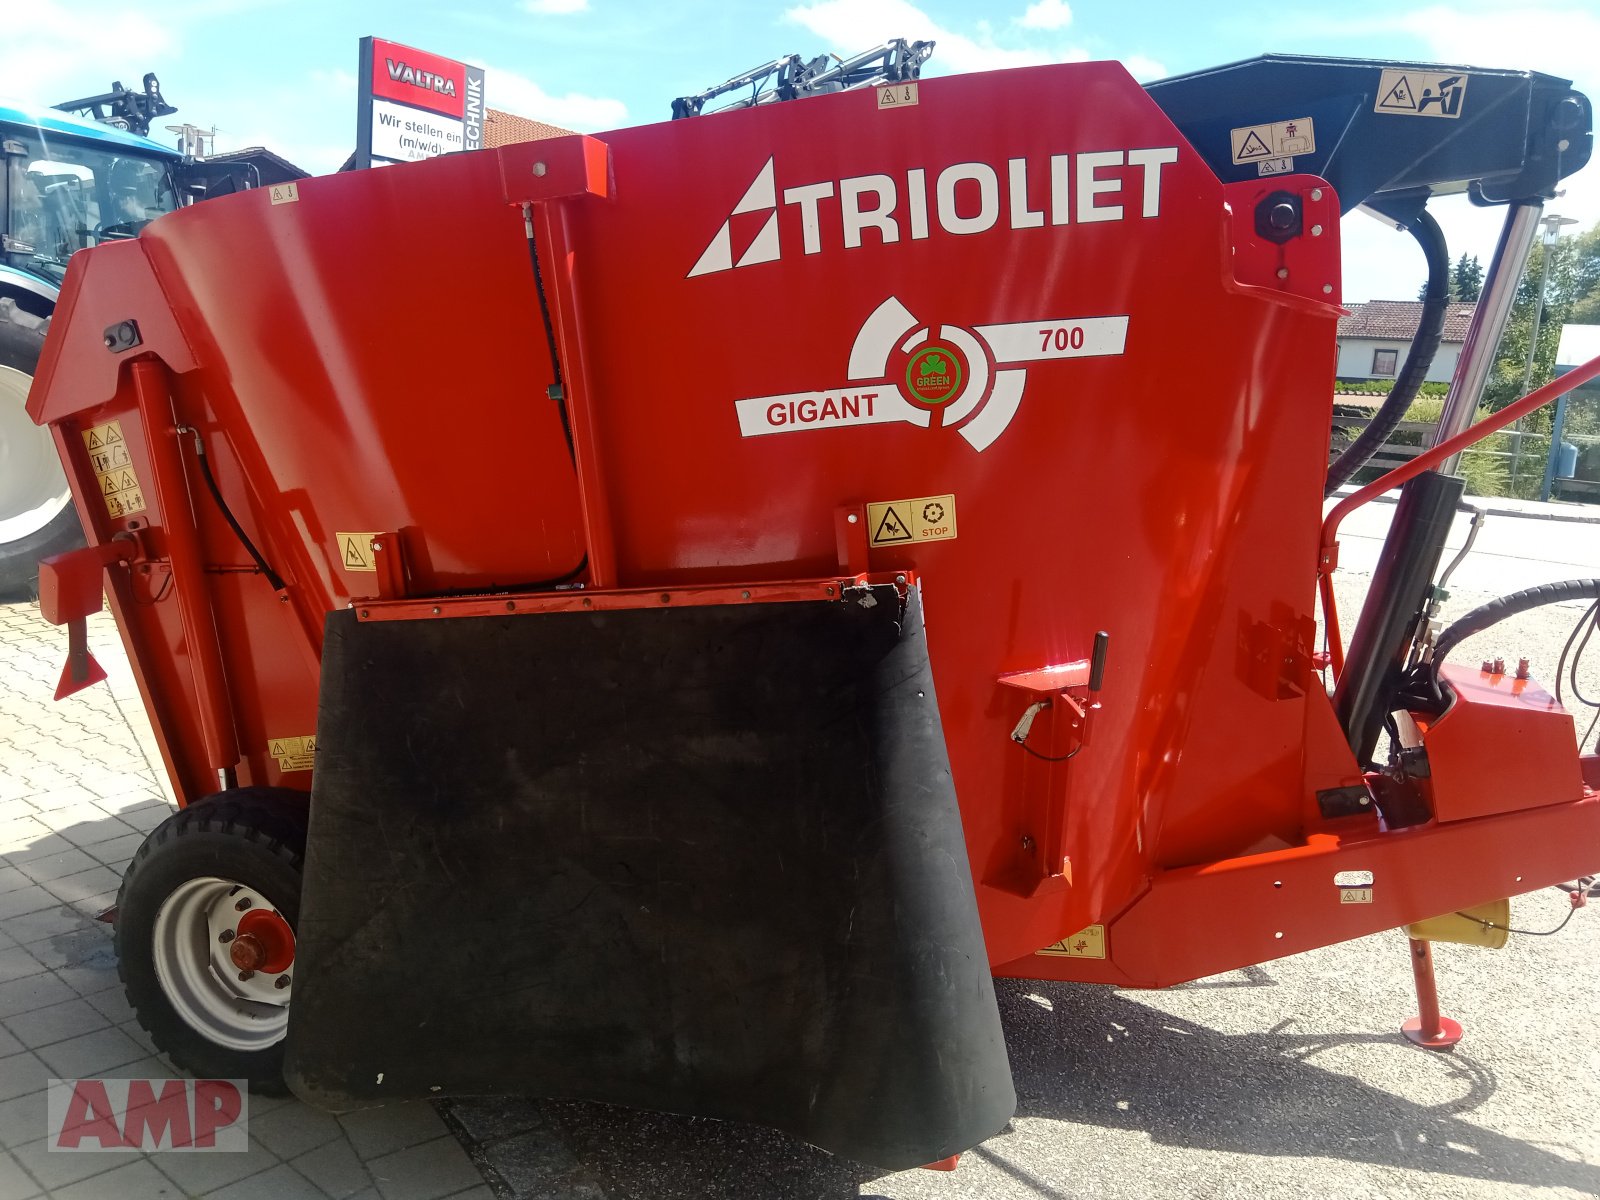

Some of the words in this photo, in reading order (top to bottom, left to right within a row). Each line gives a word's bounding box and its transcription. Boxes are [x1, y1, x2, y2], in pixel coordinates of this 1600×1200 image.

[385, 58, 456, 97] VALTRA
[379, 113, 401, 128] Wir
[405, 120, 443, 139] stellen
[446, 132, 462, 143] ein
[783, 146, 1179, 255] TRIOLIET
[1038, 326, 1085, 352] 700
[916, 376, 950, 387] GREEN
[766, 393, 879, 427] GIGANT
[922, 527, 948, 537] STOP
